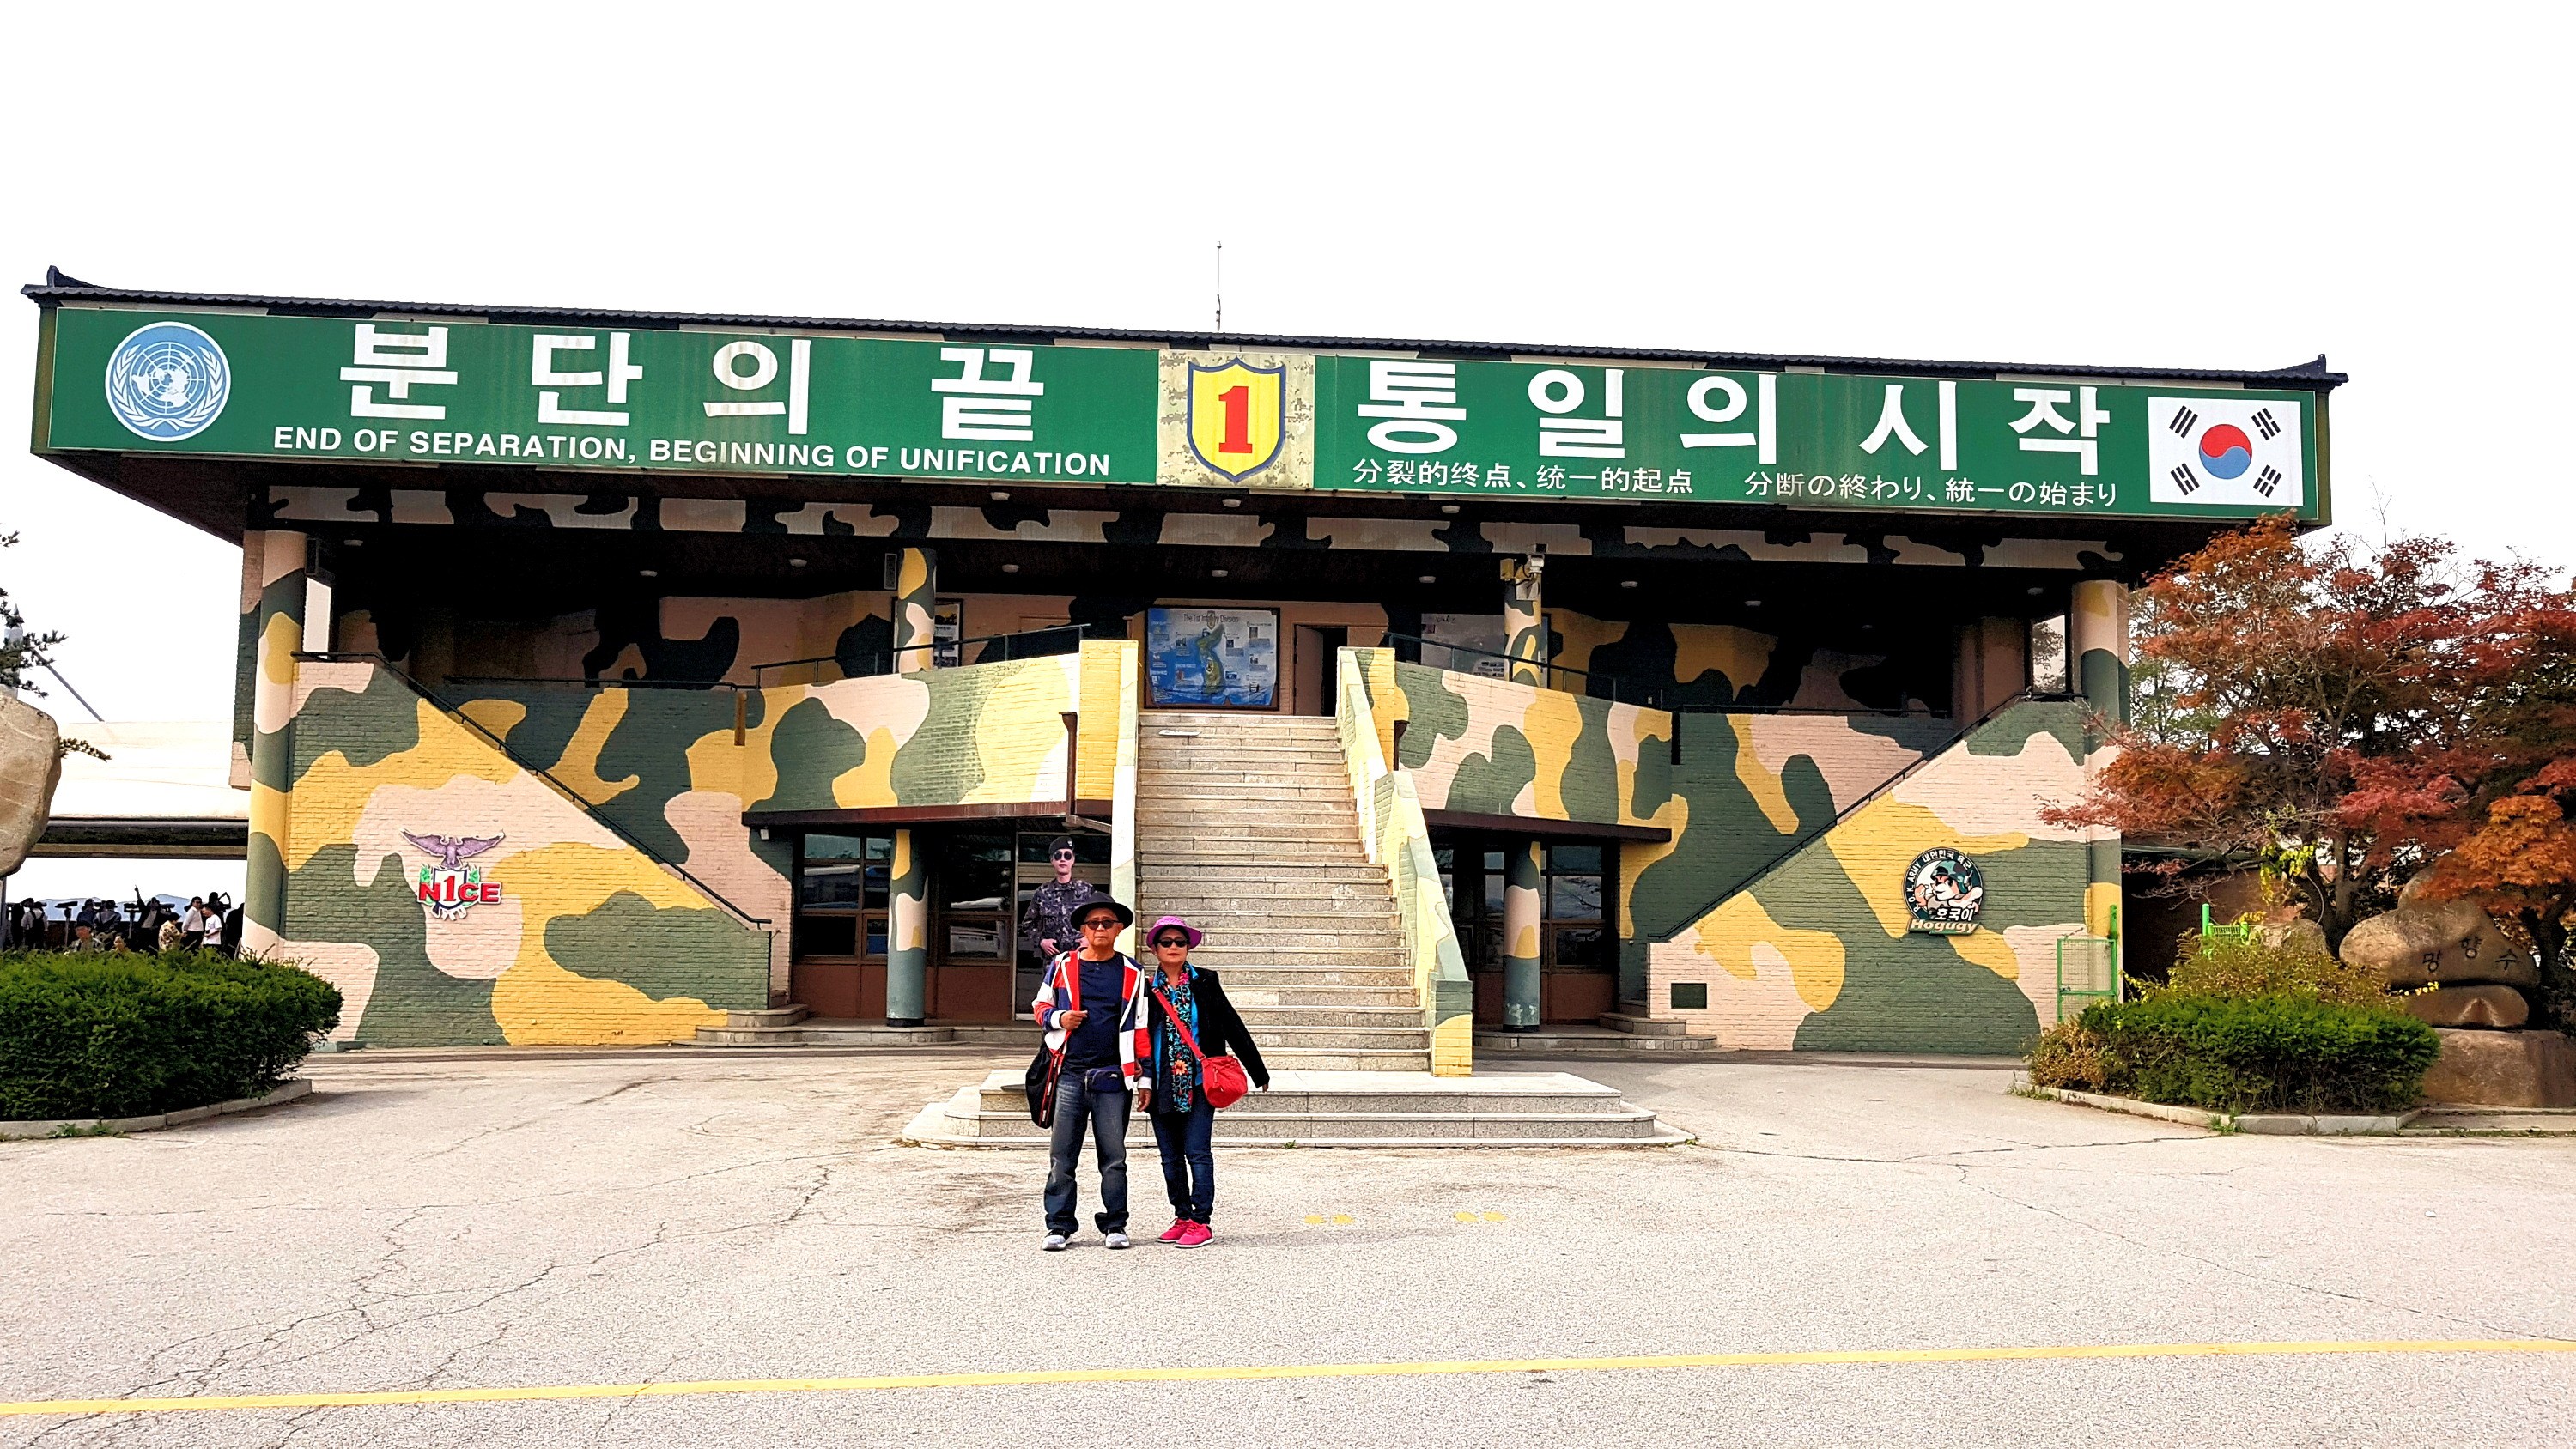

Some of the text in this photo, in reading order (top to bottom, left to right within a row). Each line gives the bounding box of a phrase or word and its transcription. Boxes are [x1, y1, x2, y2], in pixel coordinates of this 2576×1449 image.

[931, 347, 1045, 442] 끝
[1218, 385, 1254, 455] 1
[1858, 380, 2111, 476] 시작
[273, 426, 1110, 476] END OF SEPARATION, BEGINNING OF UNIFICATION
[1907, 861, 1922, 882] ARMY
[1922, 849, 1955, 863] 대한민국
[1911, 919, 1978, 932] Hogugy
[1934, 907, 1974, 922] 호국이
